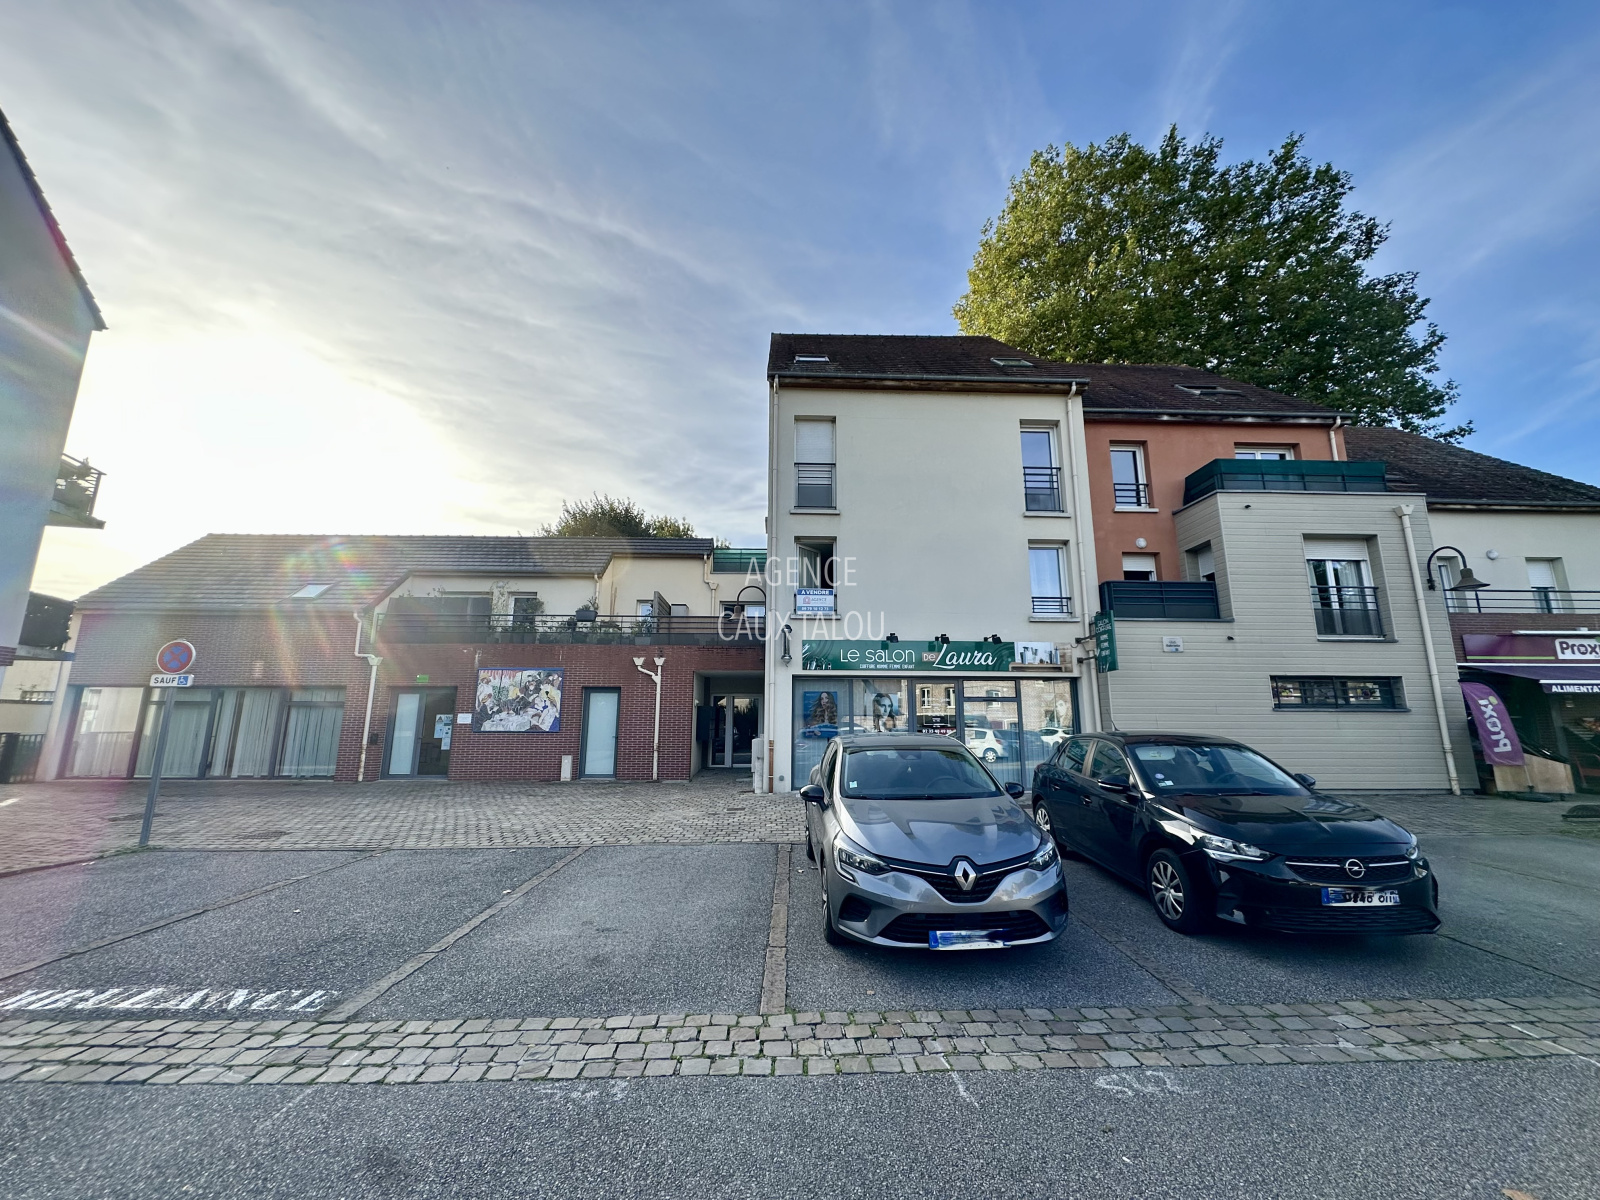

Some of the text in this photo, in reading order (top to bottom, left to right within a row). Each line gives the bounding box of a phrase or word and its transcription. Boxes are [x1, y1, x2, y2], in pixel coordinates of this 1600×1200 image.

[840, 649, 860, 663] Le
[933, 643, 997, 669] Laura
[153, 676, 177, 684] SAUF
[0, 988, 342, 1012] MBULANCE
